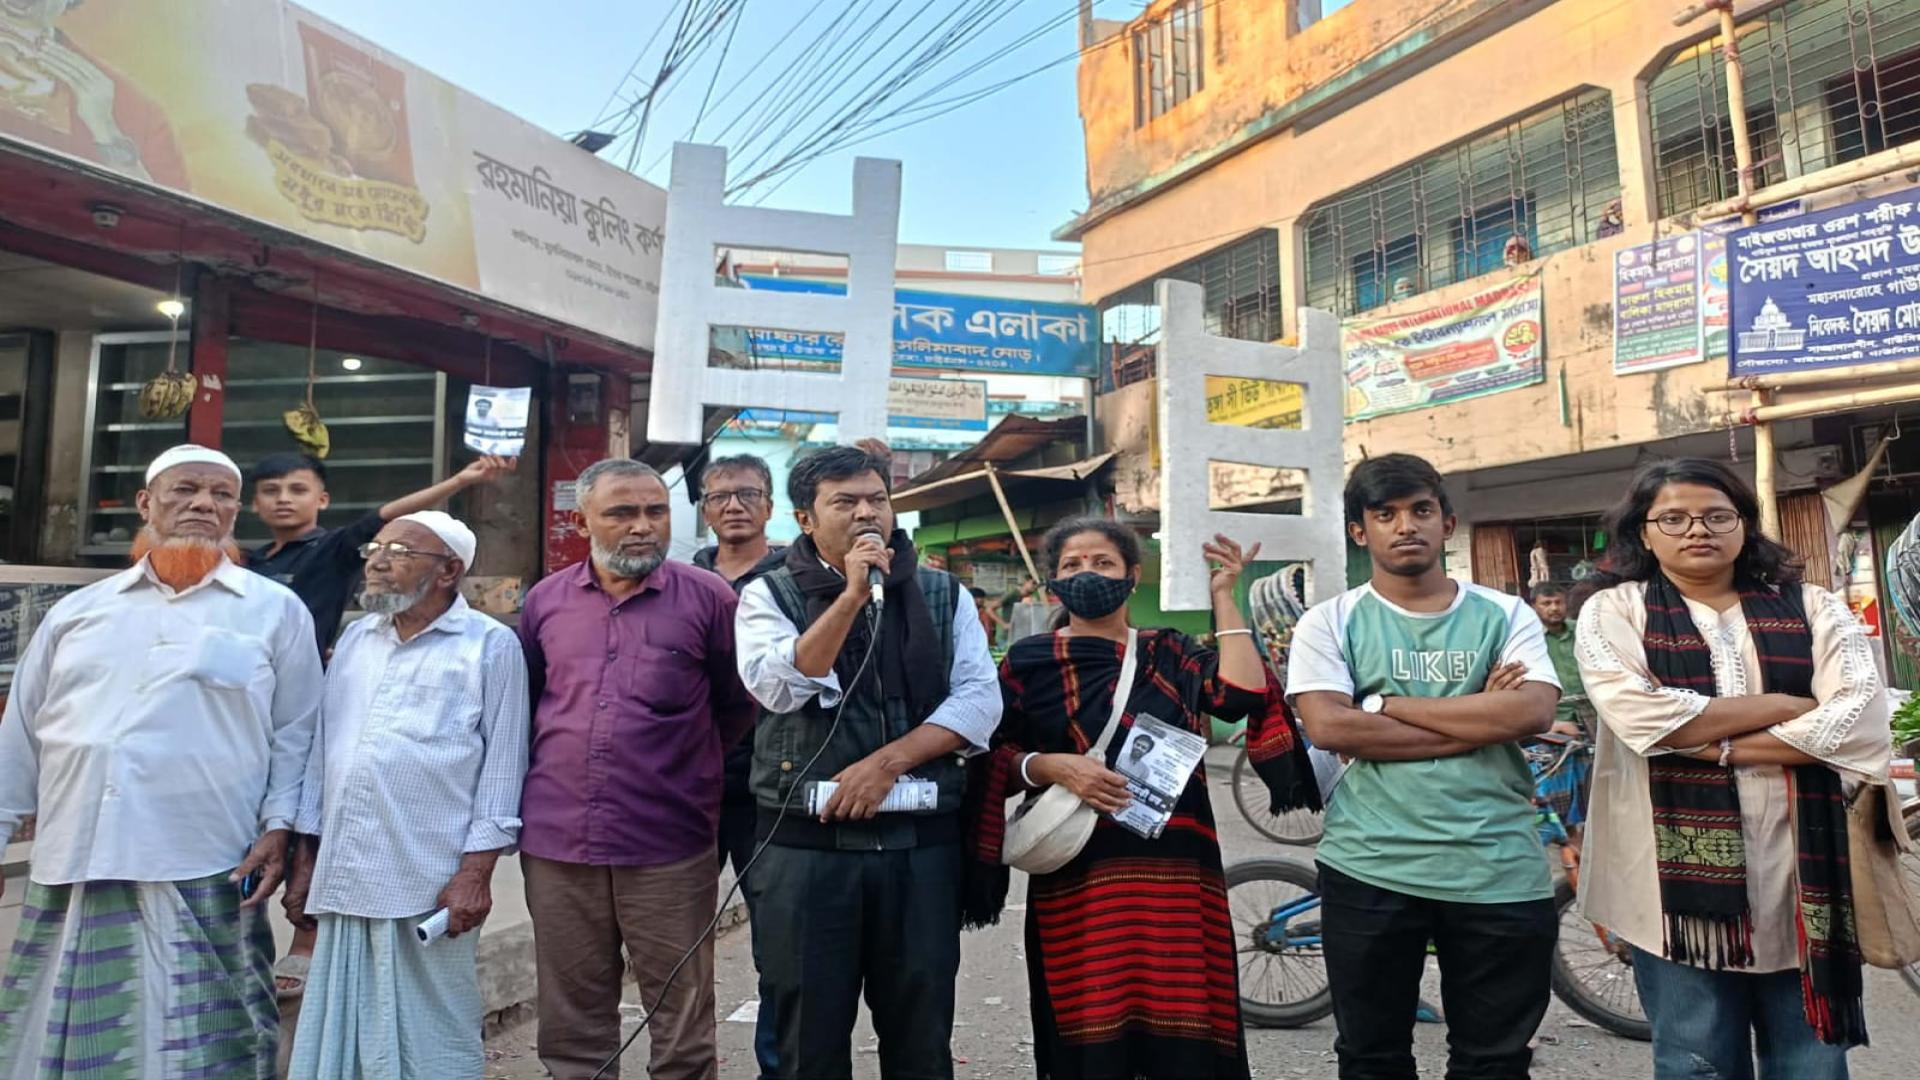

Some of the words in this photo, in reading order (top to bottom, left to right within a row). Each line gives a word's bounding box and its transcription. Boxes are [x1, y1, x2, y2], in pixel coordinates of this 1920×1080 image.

[473, 150, 578, 226] রহমানিয়া
[580, 196, 635, 255] কুলিং
[1823, 214, 1860, 234] ওরশ
[1864, 202, 1913, 224] শরীফ
[1737, 252, 1803, 283] সৈয়দ
[1805, 235, 1895, 274] আহমদ
[1897, 224, 1920, 256] উ
[1806, 284, 1884, 304] মহাসমারোহে
[965, 309, 1089, 343] এলাকা
[1850, 303, 1891, 336] সৈয়দ
[894, 337, 989, 358] সলিমাবাদ
